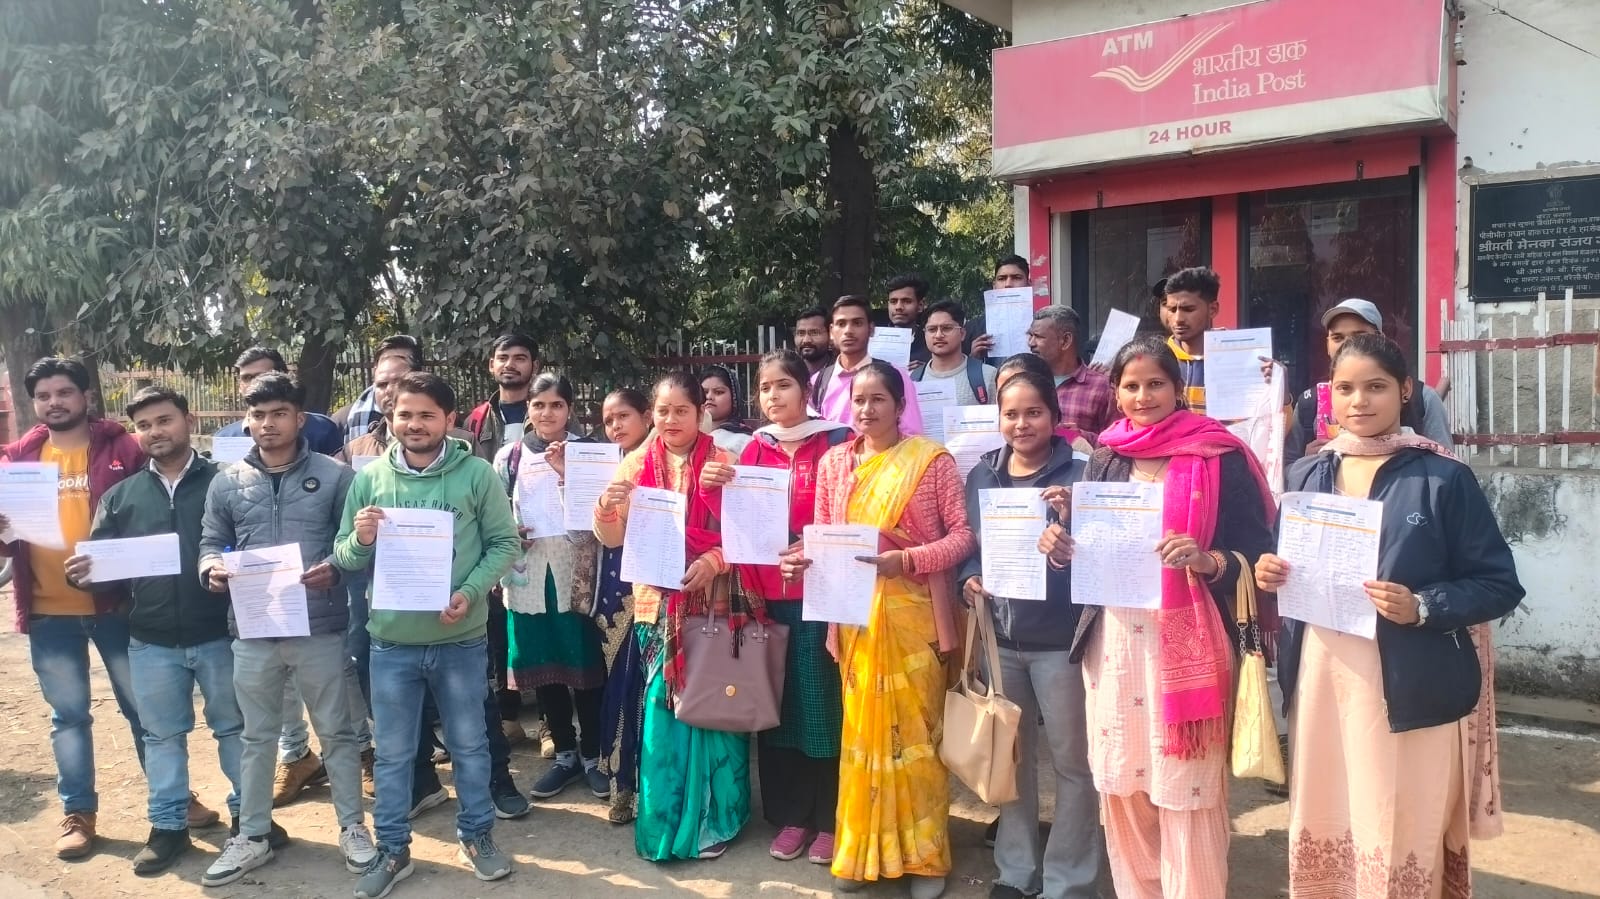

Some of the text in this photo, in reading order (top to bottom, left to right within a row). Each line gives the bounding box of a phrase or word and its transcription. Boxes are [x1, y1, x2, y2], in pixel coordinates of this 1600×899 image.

[1102, 31, 1153, 56] ATM
[1192, 40, 1308, 76] भारतीय डाक
[1192, 69, 1307, 105] India Post
[1148, 120, 1232, 145] 24 HOUR
[1478, 239, 1514, 252] श्रीमती
[1517, 237, 1557, 249] मेनका
[1559, 235, 1593, 248] संजय
